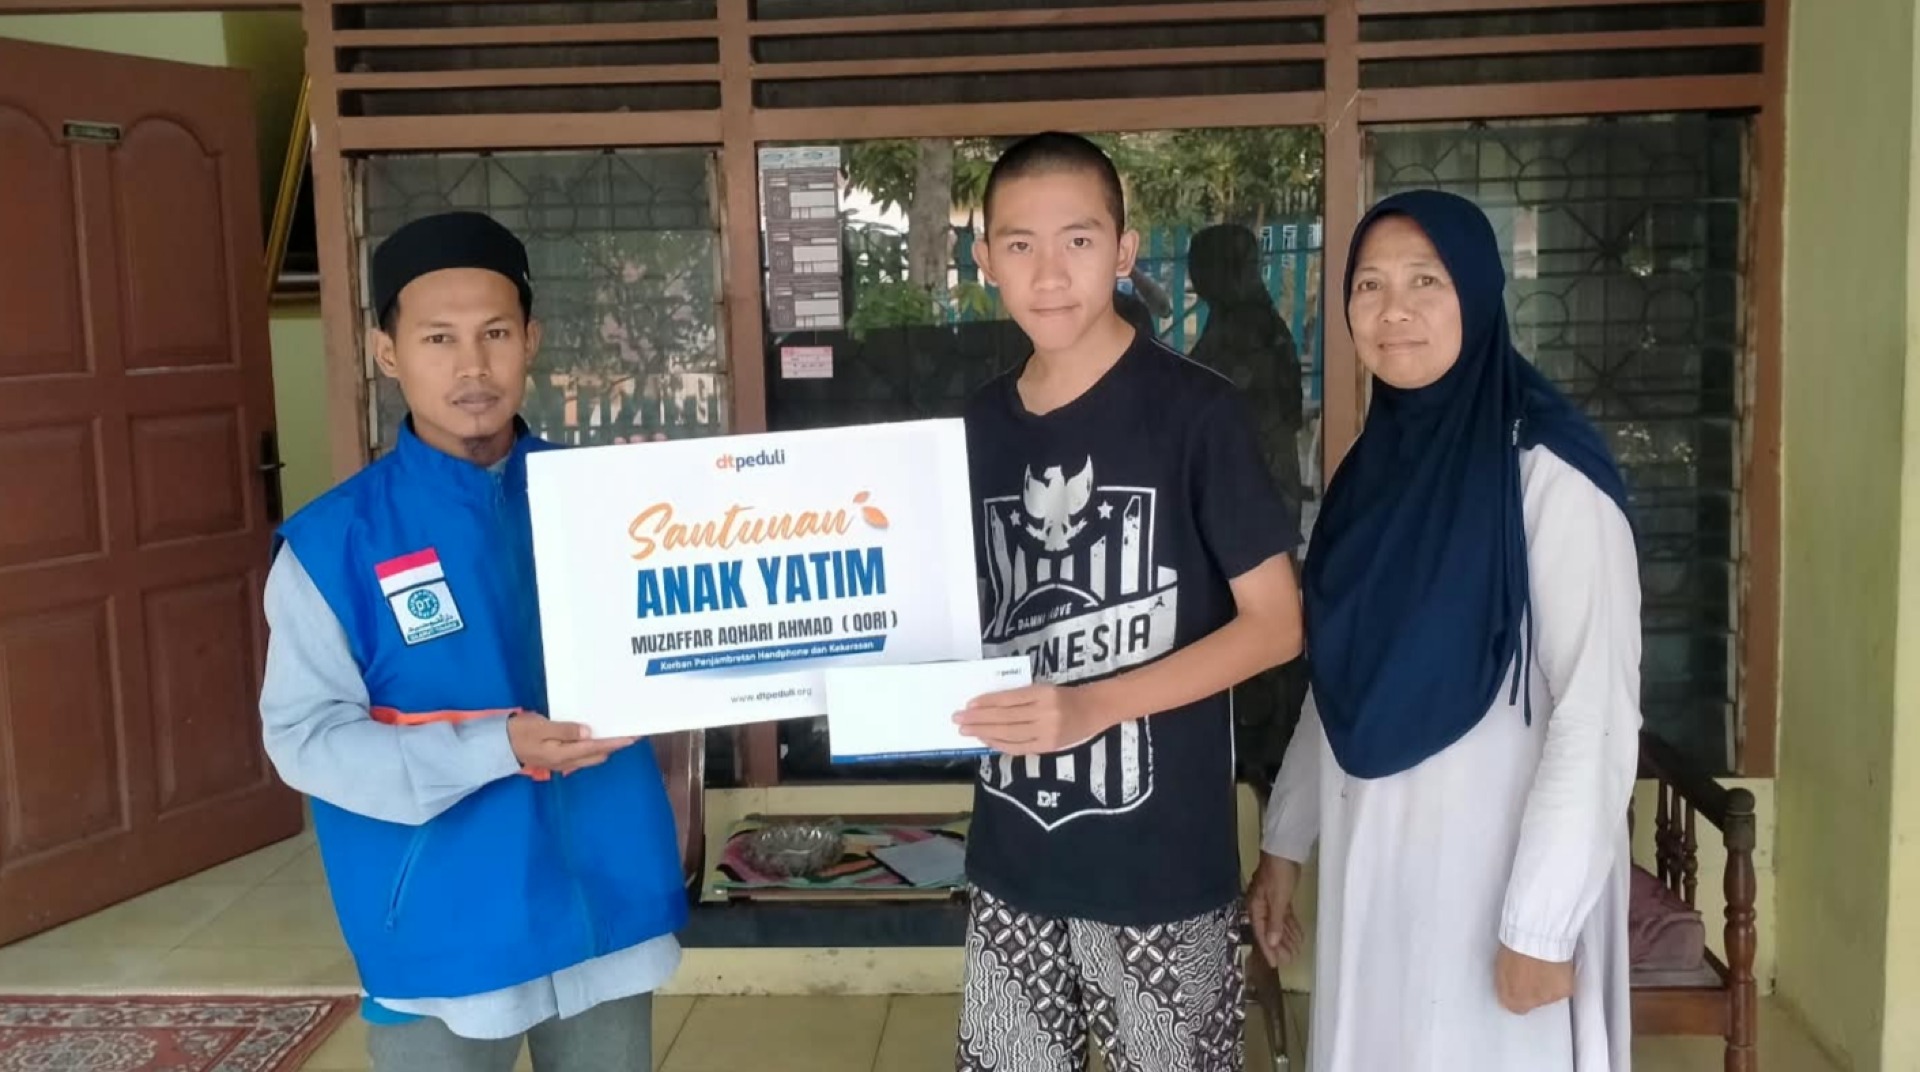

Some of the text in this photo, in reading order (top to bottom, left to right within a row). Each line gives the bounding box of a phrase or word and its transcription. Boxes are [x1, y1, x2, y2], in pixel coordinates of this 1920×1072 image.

[716, 449, 785, 472] dtpeduli
[628, 502, 854, 560] Santunan
[637, 547, 886, 619] ANAK YATIM
[631, 628, 713, 655] MUZAFFAR
[718, 622, 773, 645] AQHARI
[778, 616, 833, 639] AHMAD
[660, 640, 874, 671] Korban Penjambretan Handphone dan Kekerasan
[731, 686, 812, 703] www.dtpeduli.org
